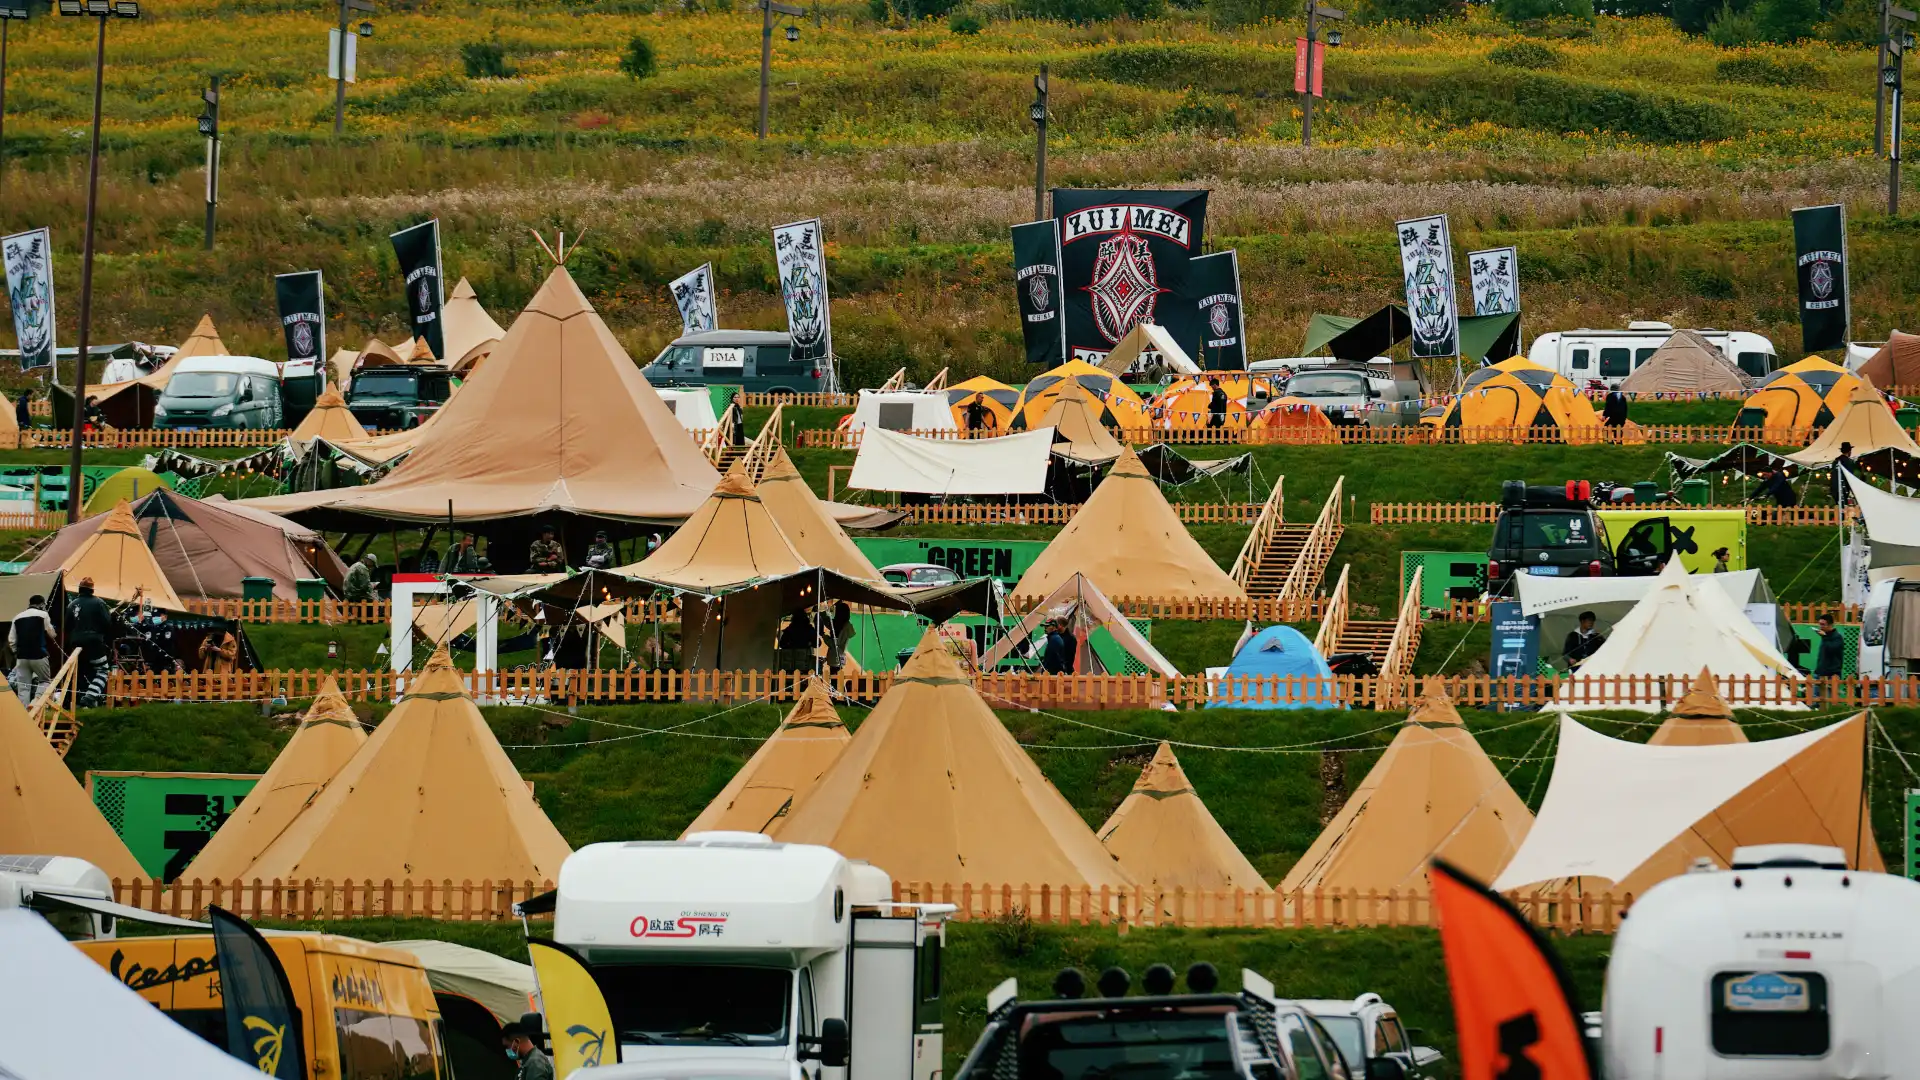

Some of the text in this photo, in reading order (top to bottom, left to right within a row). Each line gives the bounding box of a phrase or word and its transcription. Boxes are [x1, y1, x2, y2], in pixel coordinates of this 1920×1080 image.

[1068, 207, 1187, 240] ZUI MEI
[1100, 239, 1152, 262] 醉 美
[1532, 596, 1579, 608] BLACKDEER
[649, 918, 675, 931] 欧盛
[698, 924, 724, 937] 房车
